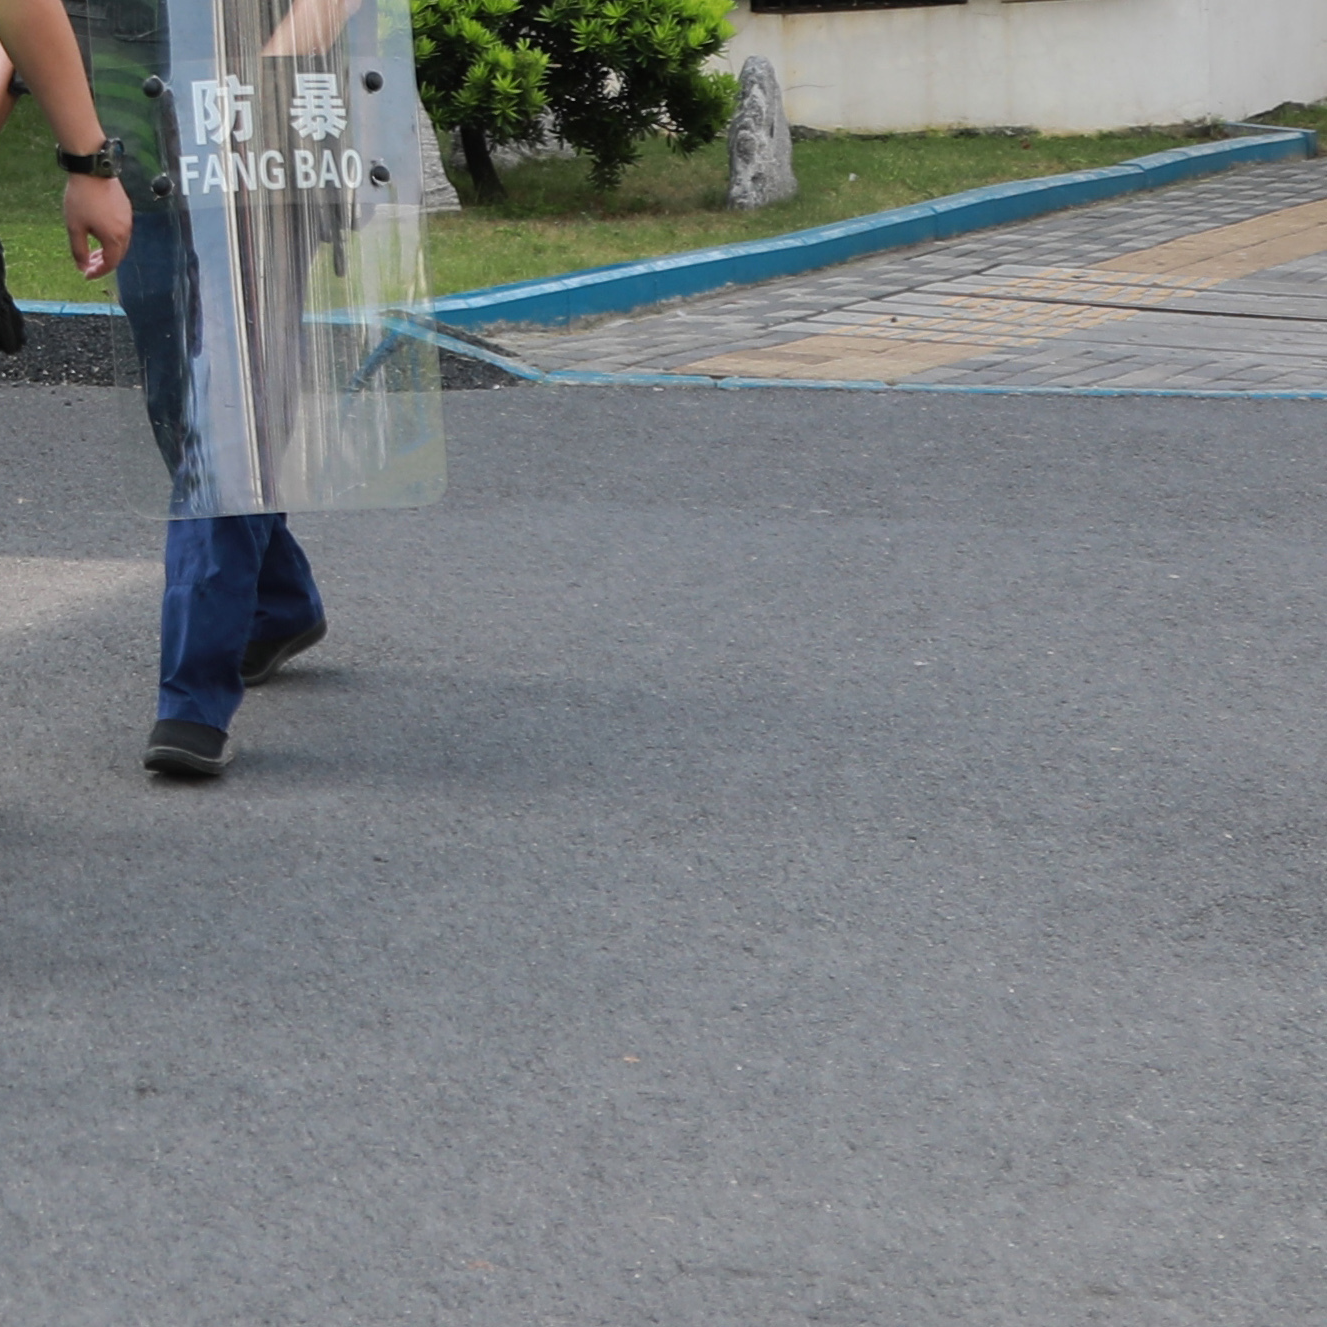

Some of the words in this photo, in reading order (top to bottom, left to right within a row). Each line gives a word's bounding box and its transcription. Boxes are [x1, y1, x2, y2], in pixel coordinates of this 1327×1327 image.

[190, 73, 348, 146] 防暴
[179, 149, 287, 195] FANG
[295, 148, 363, 191] BAO
